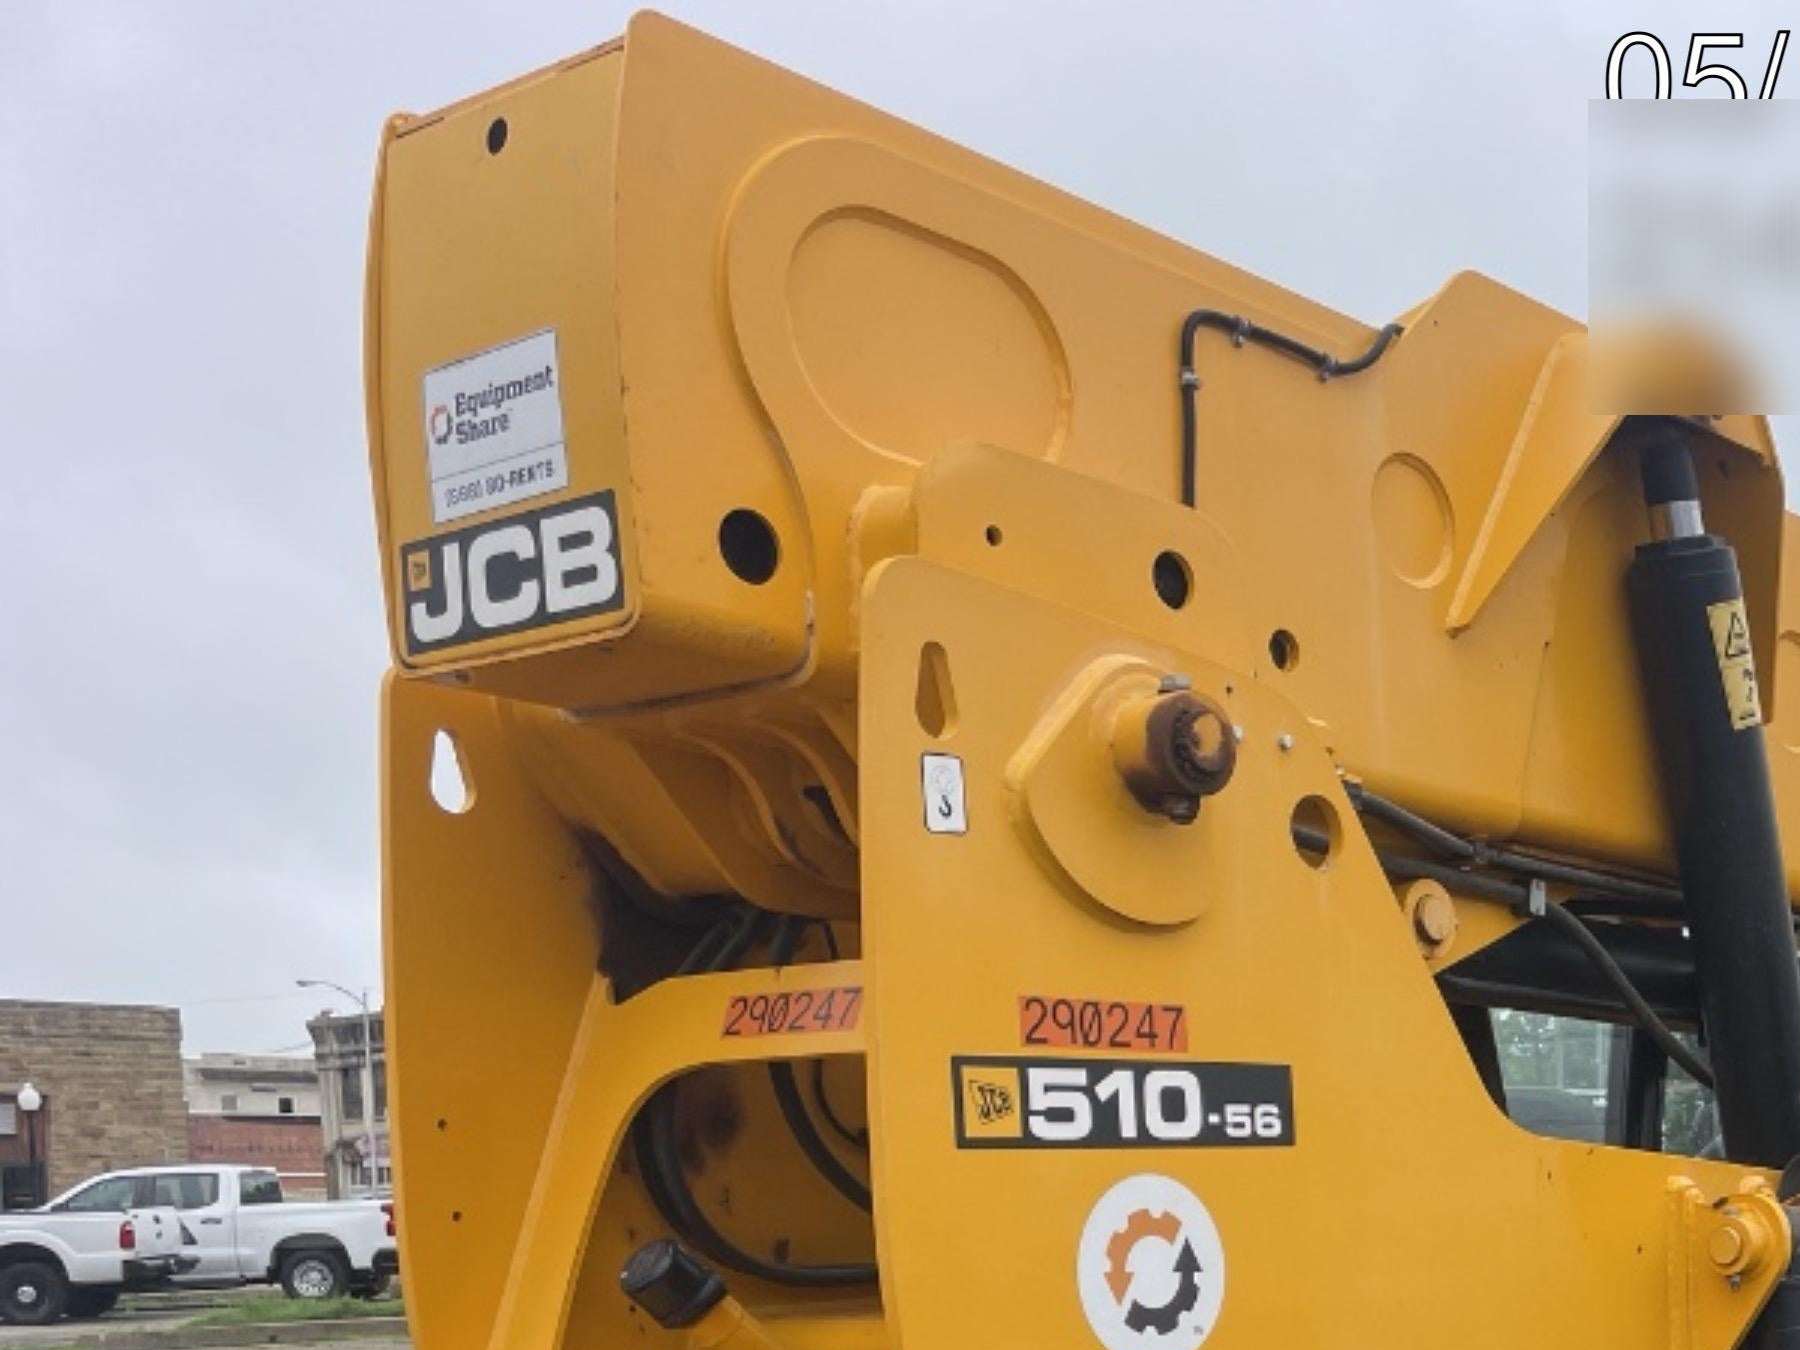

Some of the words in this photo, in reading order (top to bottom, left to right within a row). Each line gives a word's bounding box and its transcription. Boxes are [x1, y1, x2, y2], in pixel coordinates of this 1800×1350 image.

[455, 365, 552, 417] Equipment
[455, 412, 509, 444] Share
[410, 506, 618, 643] JCB
[723, 986, 862, 1036] 290247
[1024, 996, 1184, 1050] 290247
[1027, 1066, 1282, 1141] 510-56
